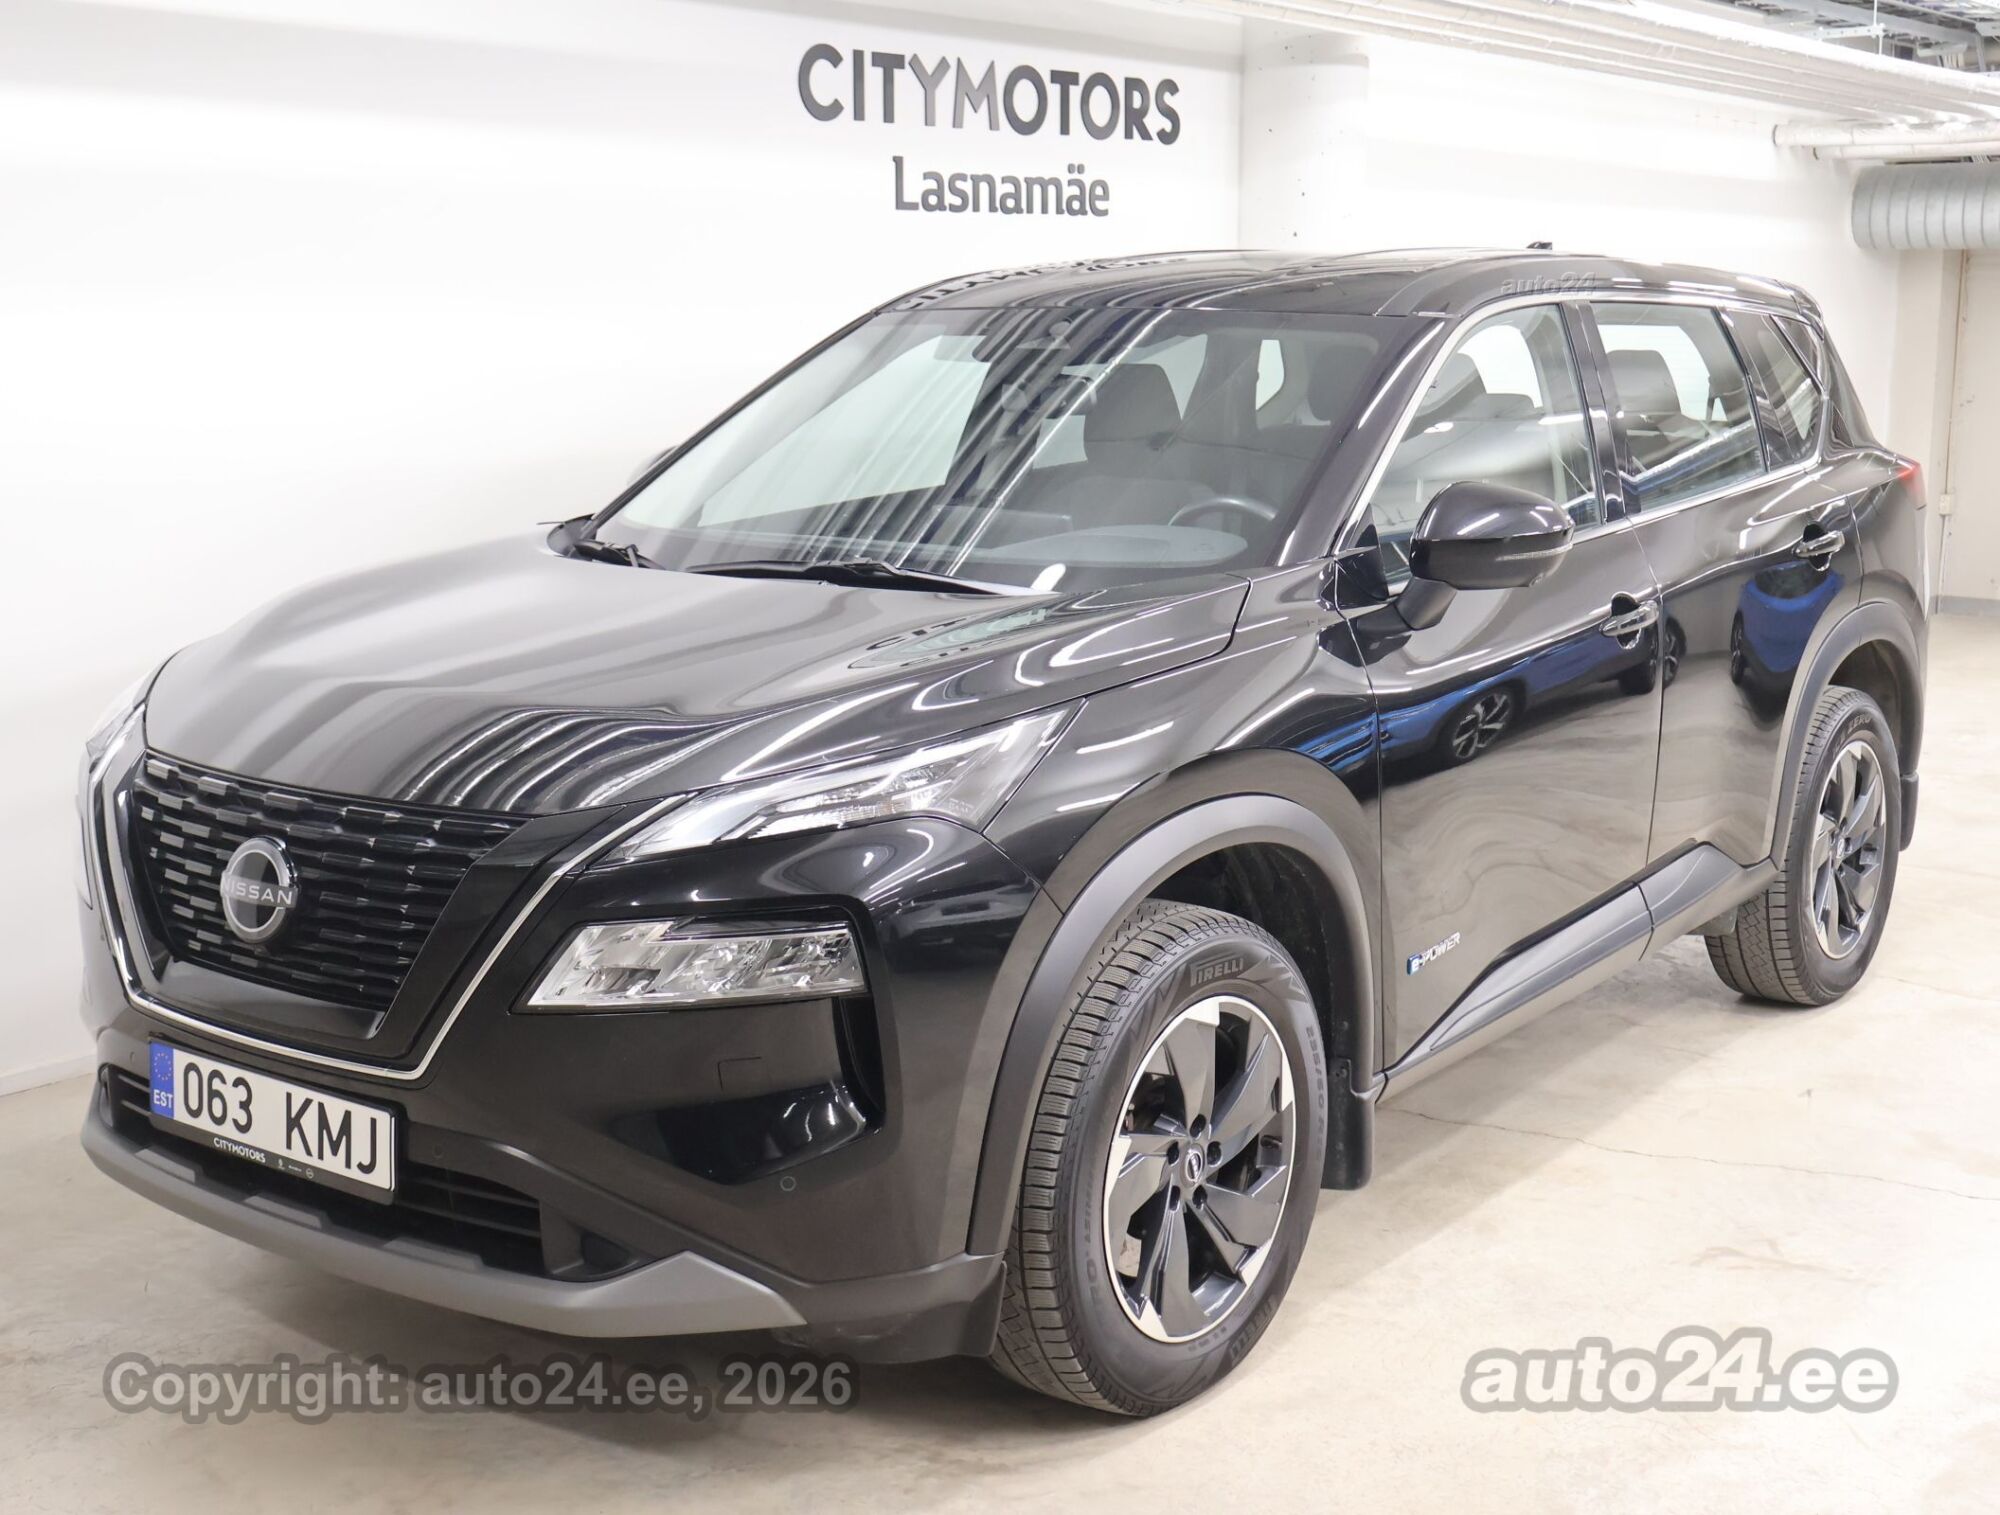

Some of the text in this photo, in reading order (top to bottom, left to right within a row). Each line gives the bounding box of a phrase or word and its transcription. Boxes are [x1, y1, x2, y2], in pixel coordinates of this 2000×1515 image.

[798, 43, 1181, 146] CITYMOTORS
[892, 155, 1110, 217] Lasnamäe
[222, 873, 293, 905] NISSAN
[1189, 953, 1245, 988] PIRELLI
[153, 1088, 174, 1109] EST
[183, 1061, 378, 1175] 063 KMJ
[213, 1136, 266, 1164] CITYMOTORS
